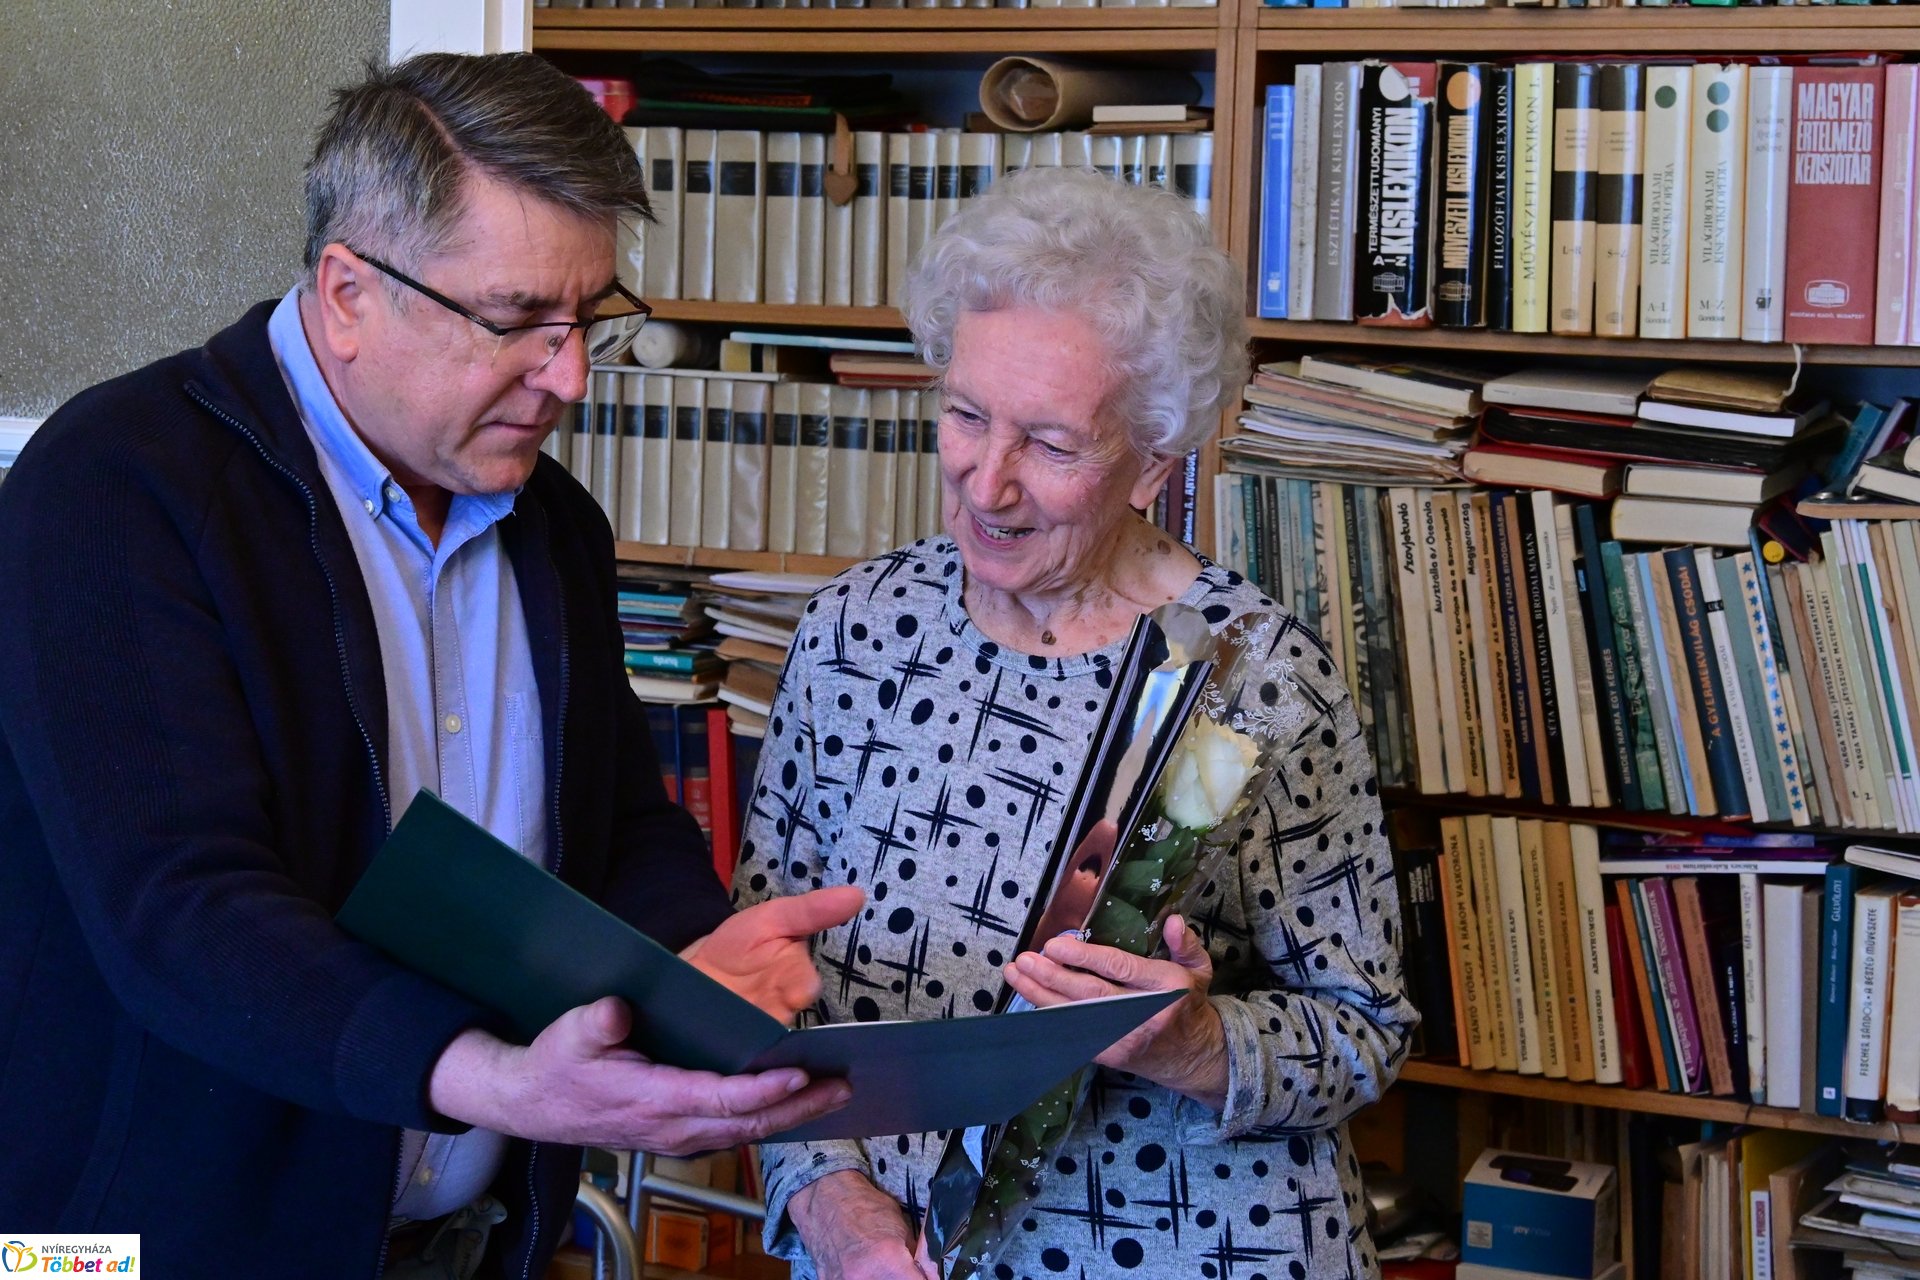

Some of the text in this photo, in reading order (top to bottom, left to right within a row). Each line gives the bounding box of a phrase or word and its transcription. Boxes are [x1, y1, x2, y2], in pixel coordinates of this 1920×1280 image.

[1798, 83, 1874, 120] MAGYAR
[1525, 95, 1538, 174] LEXIKON
[1797, 119, 1873, 152] ÉRTELMEZŐ
[1328, 81, 1345, 266] ESZTÉTIKAI KISLEXIKON
[1368, 107, 1382, 254] TERMÉSZETTUDOMÁNYI
[1380, 107, 1419, 254] KISLEXIKON
[1443, 115, 1474, 269] MŰVÉSZETI KISLEXIKON
[1494, 84, 1508, 269] FILOZÓFIAI KISLEXIKON
[1795, 153, 1871, 185] KÉZISZÓTÁR
[1521, 180, 1537, 280] MŰVÉSZETI
[1650, 172, 1662, 265] VILÁGIRODALMI
[1702, 170, 1715, 263] VILÁGIRODALMI
[1398, 502, 1416, 573] Szovjetunió
[1422, 501, 1435, 544] Óceánia
[1440, 507, 1455, 566] Szovjetunió
[1494, 504, 1510, 574] BIRODALMÁBAN
[1429, 561, 1442, 613] Ausztrália
[1503, 575, 1513, 604] FIZIKA
[1676, 565, 1697, 616] CSODÁI
[1452, 596, 1463, 634] Európa
[1524, 532, 1557, 736] SÉTA A MATEMATIKA BIRODALMÁBAN
[653, 655, 678, 667] burda
[1507, 613, 1522, 683] KALANDOZÁSOK
[1686, 619, 1720, 724] GYERMEKVILÁG
[1457, 649, 1472, 721] olvasókönyv
[1494, 651, 1509, 723] olvasókönyv
[1805, 589, 1850, 768] VARGA TAMÁS JÁTSSZUNK MATEMATIKÁT!
[1818, 590, 1864, 769] VARGA TAMÁS JÁTSSZUNK MATEMATIKÁT!
[1520, 719, 1529, 743] HANS
[1601, 648, 1631, 784] MINDEN NAPRA EGY KÉRDÉS
[1710, 727, 1721, 737] A
[1466, 726, 1478, 776] Földrajzi
[1503, 728, 1516, 780] Földrajzi
[1741, 751, 1753, 782] WALTER
[1449, 834, 1463, 897] VASKORONA
[1456, 901, 1468, 939] HÁROM
[1508, 908, 1516, 933] KAPU
[1536, 918, 1544, 935] OTT
[1864, 908, 1877, 954] MŰVÉSZETE
[1464, 960, 1476, 1001] GYÖRGY
[1510, 935, 1520, 975] NYUGATI
[1862, 956, 1874, 985] BESZÉD
[1587, 908, 1607, 1069] VARGA DOMOKOS ARANYHOMOK
[1468, 1005, 1481, 1044] SZÁNTÓ
[1859, 1000, 1872, 1039] SÁNDOR
[1859, 1042, 1870, 1076] FISCHER
